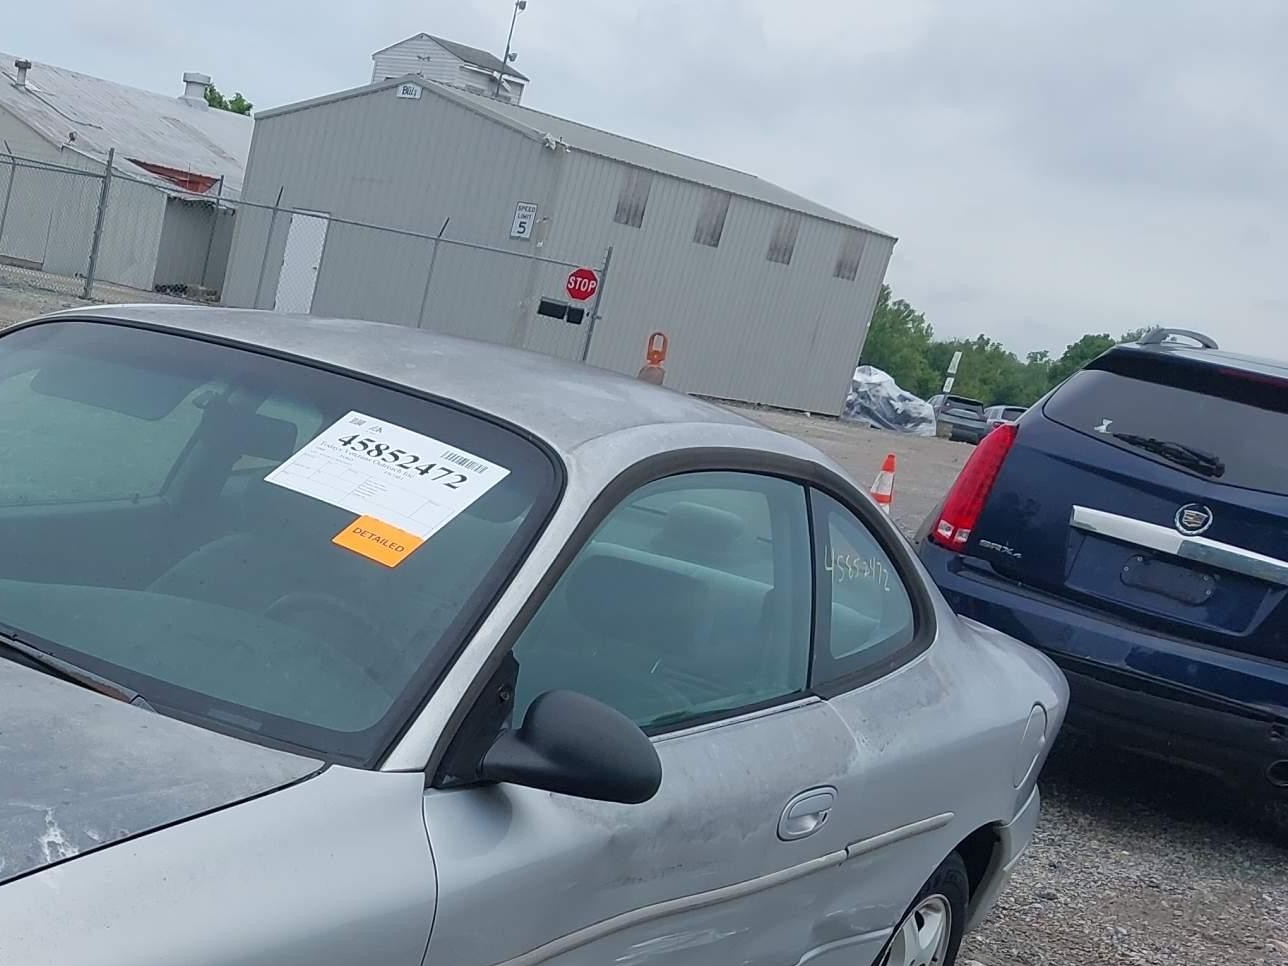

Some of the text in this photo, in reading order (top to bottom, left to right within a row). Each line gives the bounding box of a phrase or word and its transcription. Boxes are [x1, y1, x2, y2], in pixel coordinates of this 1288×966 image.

[517, 212, 532, 220] LIMIT
[518, 205, 536, 213] SPEED
[517, 221, 527, 234] 5
[568, 276, 597, 293] STOP
[338, 434, 468, 489] 45852472
[353, 527, 405, 553] DETAILED
[825, 545, 890, 592] 45852472
